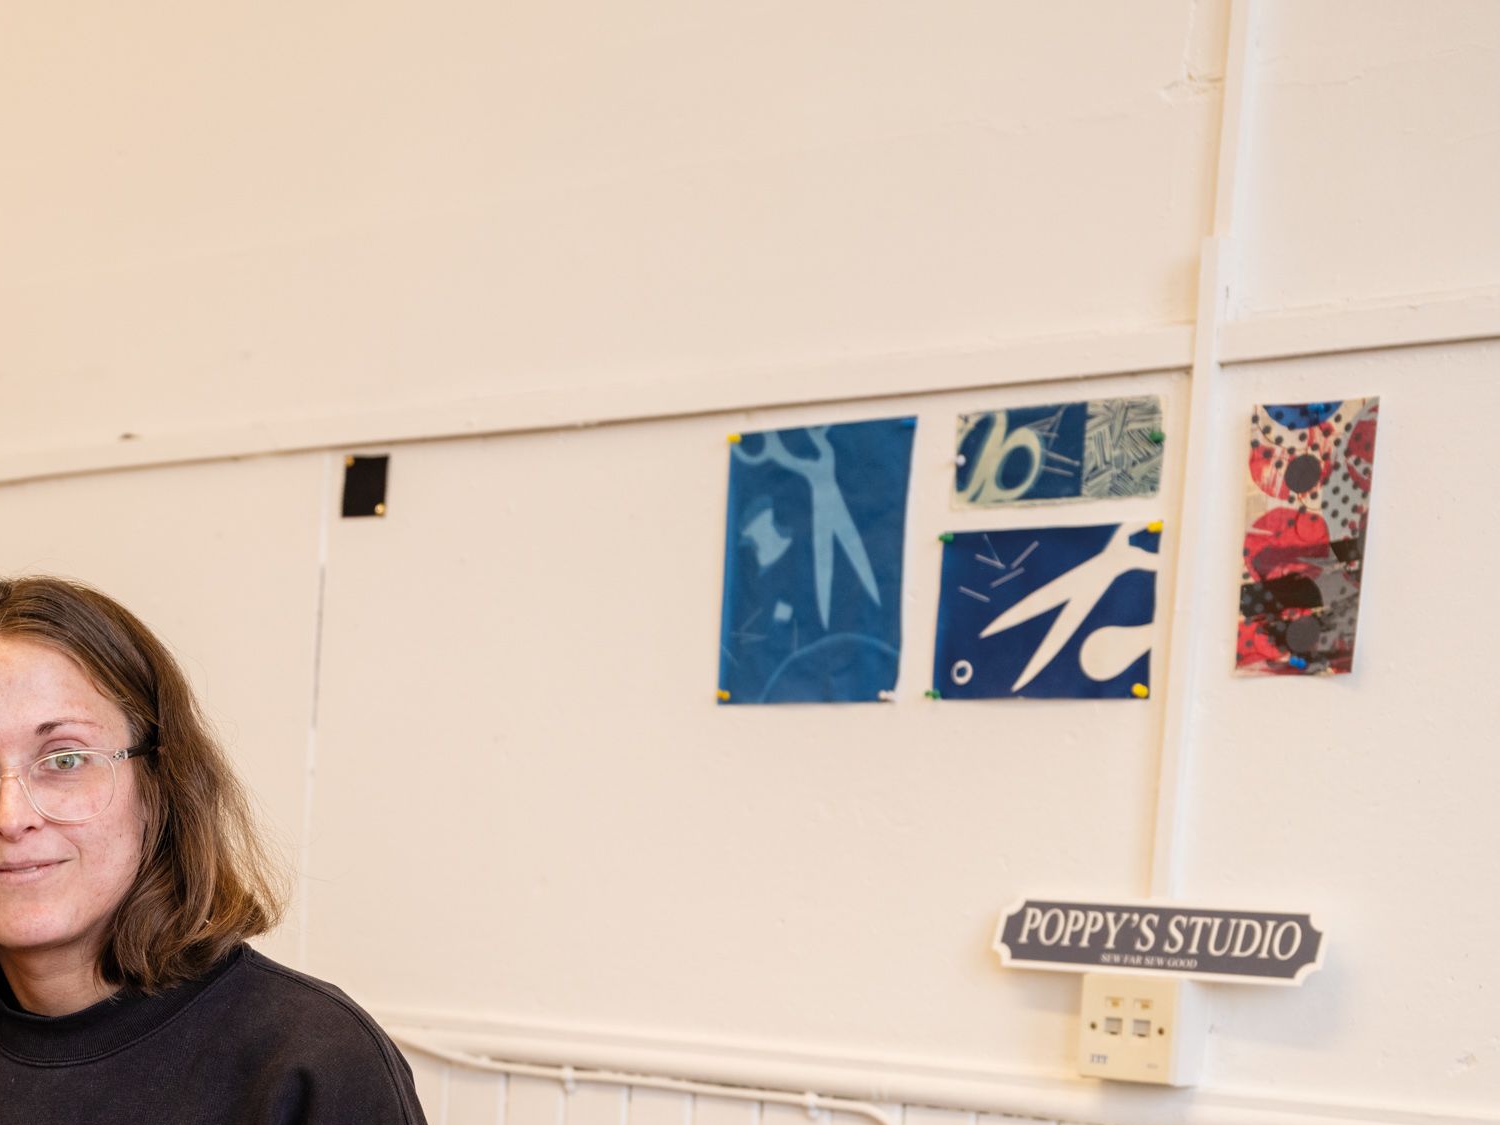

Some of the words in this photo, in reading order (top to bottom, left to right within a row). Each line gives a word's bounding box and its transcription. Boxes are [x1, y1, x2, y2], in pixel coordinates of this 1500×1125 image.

[1017, 907, 1160, 951] POPPY'S
[1163, 915, 1302, 961] STUDIO
[1100, 953, 1122, 964] SEW
[1123, 954, 1143, 965] FAR
[1144, 956, 1165, 967] SEW
[1167, 957, 1198, 969] GOOD
